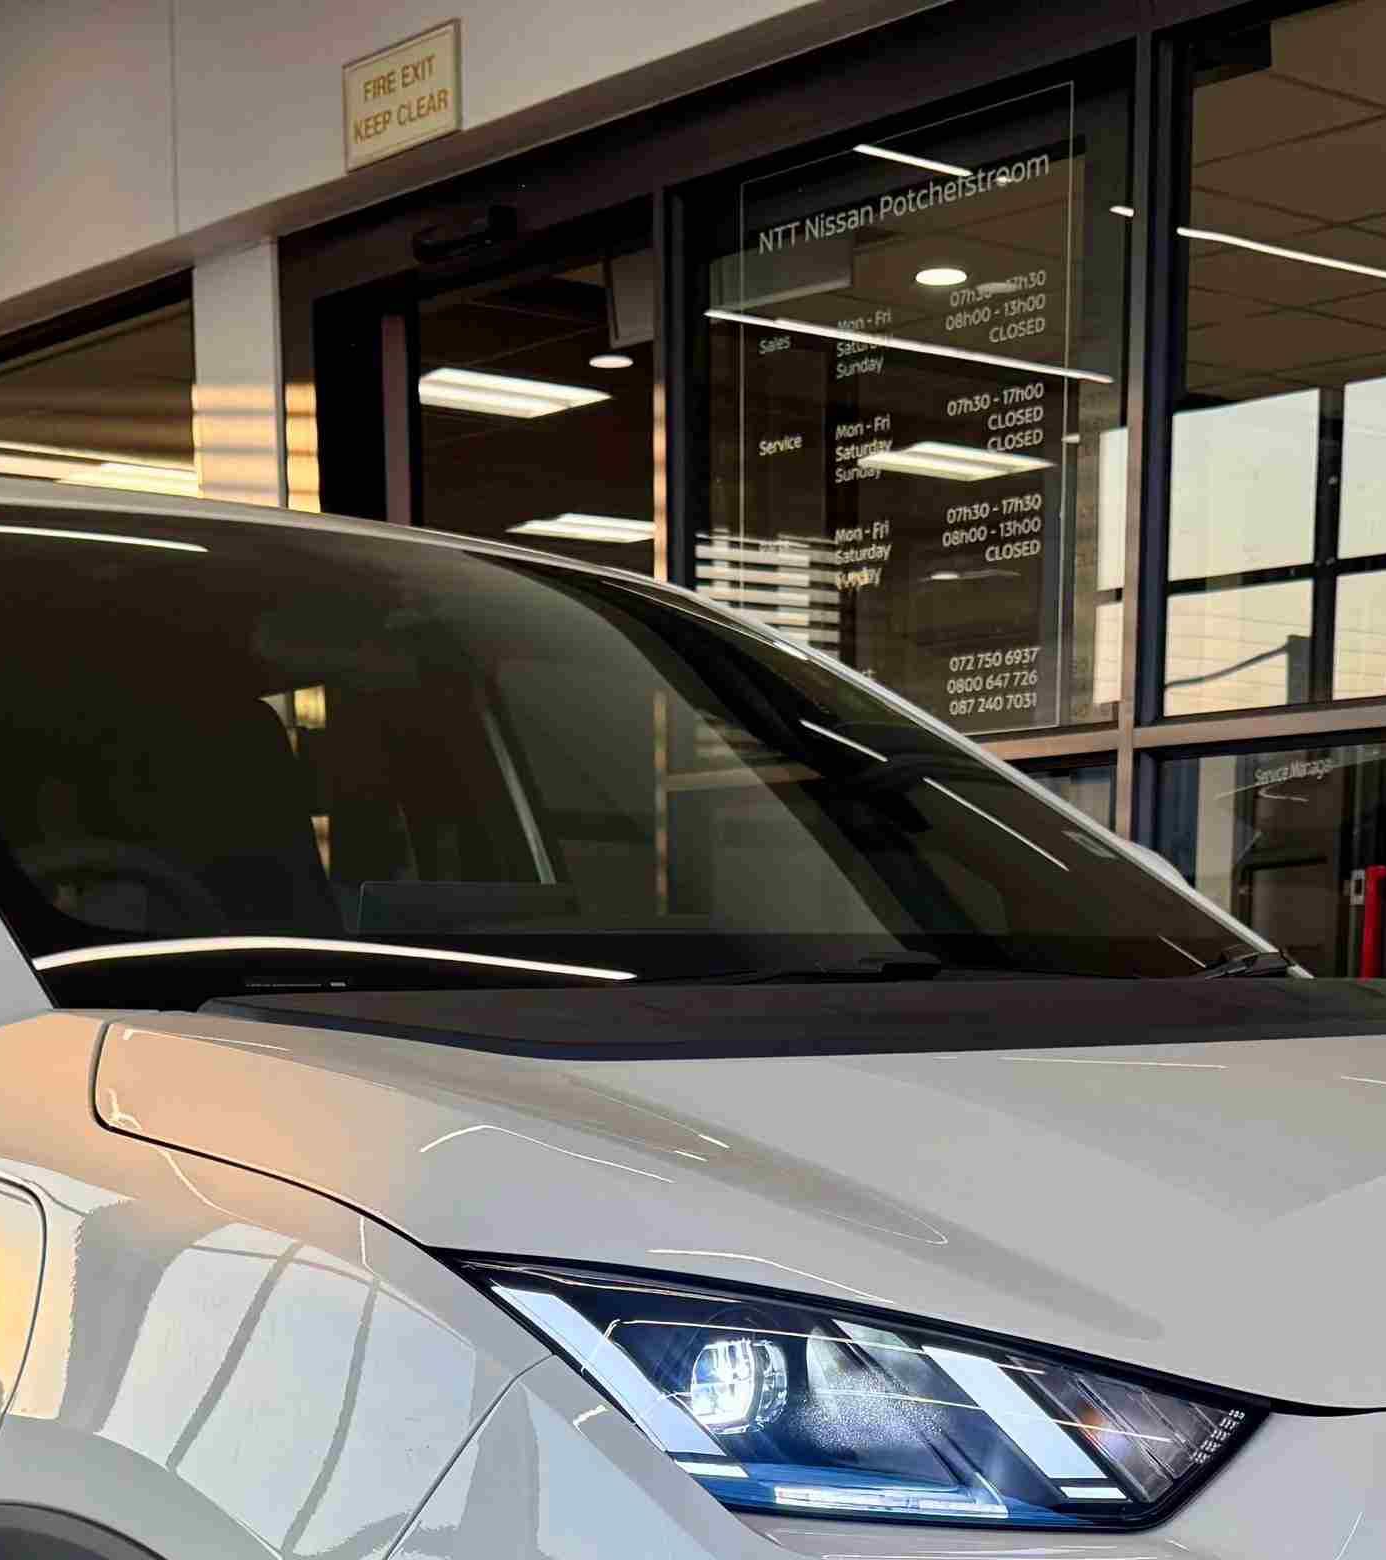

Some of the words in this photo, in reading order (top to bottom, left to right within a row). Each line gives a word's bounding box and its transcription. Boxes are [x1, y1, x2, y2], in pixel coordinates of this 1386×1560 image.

[364, 70, 397, 102] FIRE
[401, 54, 436, 88] EXIT
[353, 109, 392, 144] KEEP
[396, 88, 449, 127] CLEAR
[758, 221, 801, 255] NTT
[804, 204, 874, 241] Nissan
[879, 153, 1050, 221] Potchefstroom
[874, 308, 892, 327] Fri
[945, 307, 991, 331] 08h00
[1005, 294, 1046, 317] 13h00
[989, 317, 1045, 342] CLOSED
[758, 335, 791, 355] Sales
[836, 355, 884, 380] Sunday
[947, 393, 990, 417] 07h30
[1003, 382, 1044, 405] 17h00
[835, 423, 864, 440] Mon
[873, 412, 891, 433] Fri
[987, 406, 1043, 430] CLOSED
[758, 435, 802, 457] Service
[987, 429, 1043, 452] CLOSED
[947, 502, 990, 524] 07h30
[1002, 493, 1042, 515] 17h30
[835, 528, 863, 545] Mon
[873, 519, 890, 540] Fri
[942, 525, 988, 547] 08h00
[999, 516, 1041, 539] 13h00
[835, 543, 892, 565] Saturday
[985, 539, 1041, 561] CLOSED
[949, 656, 974, 672] 072
[976, 652, 1002, 669] 750
[1004, 646, 1040, 665] 6937
[947, 676, 983, 694] 0800
[985, 673, 1010, 689] 647
[1012, 669, 1037, 686] 726
[949, 700, 975, 716] 087
[977, 695, 1003, 712] 240
[1005, 692, 1037, 710] 7031
